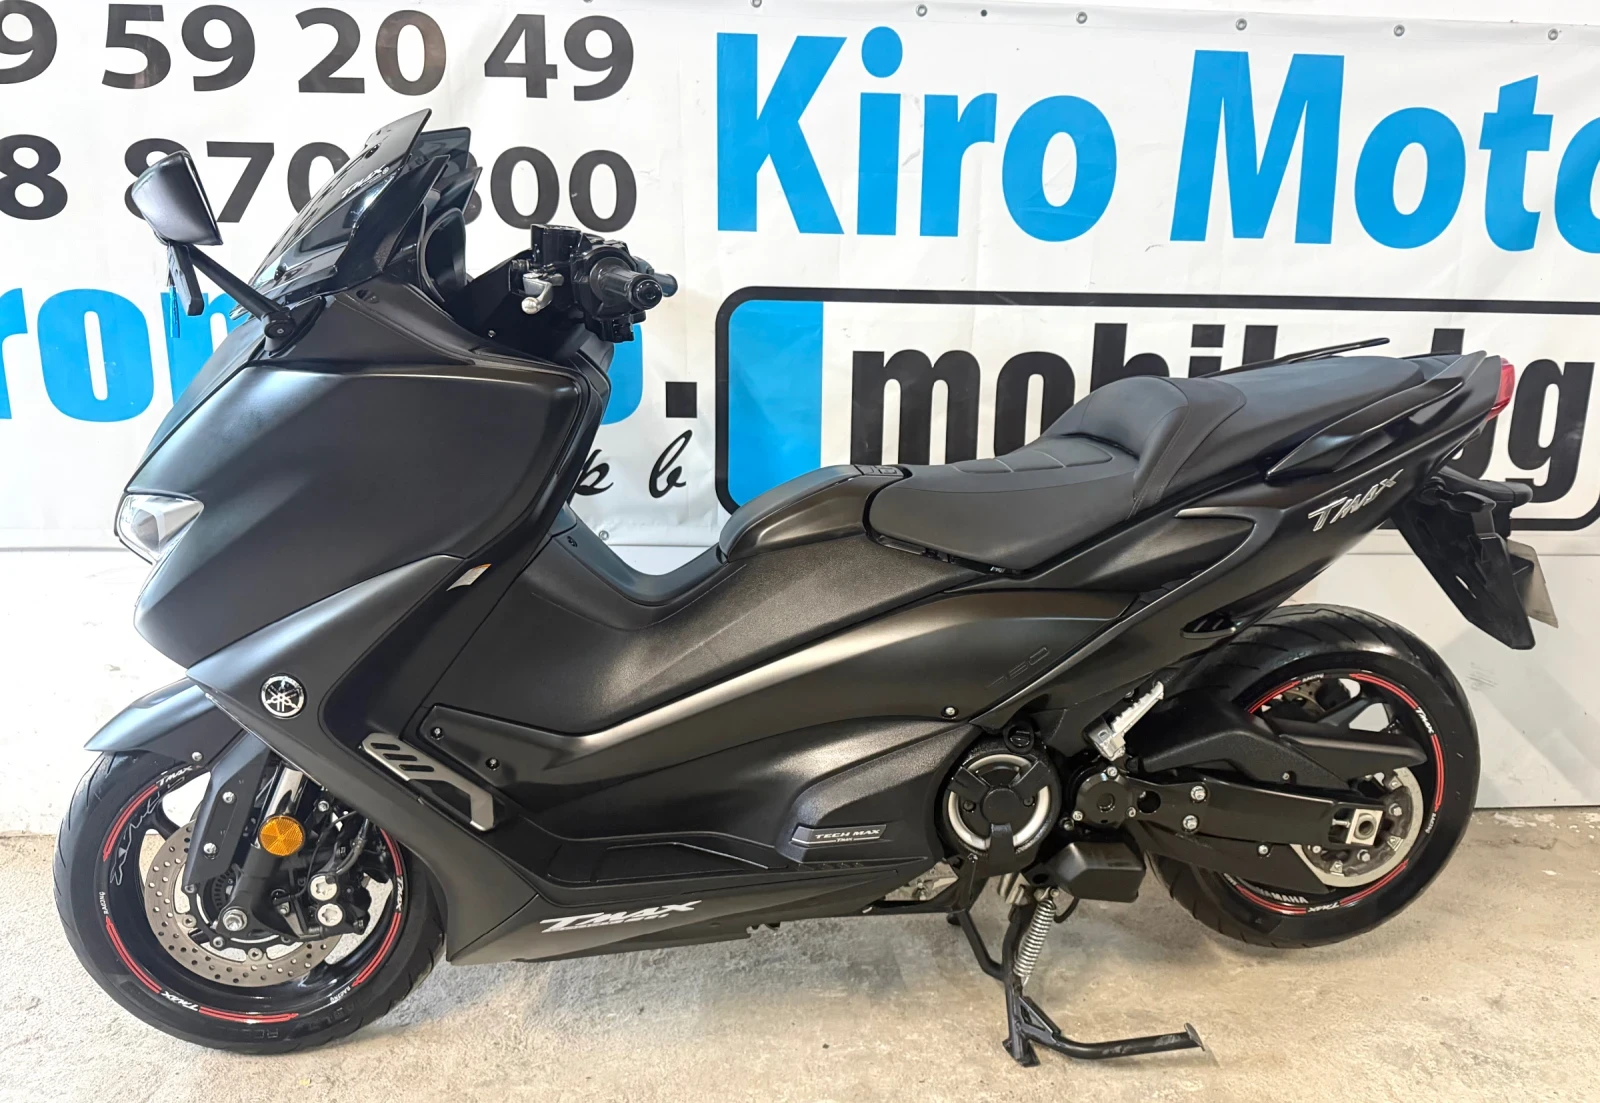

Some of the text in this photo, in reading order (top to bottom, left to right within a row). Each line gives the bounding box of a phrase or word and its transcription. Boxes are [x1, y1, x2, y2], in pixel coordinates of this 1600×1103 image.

[102, 4, 255, 91] 59
[296, 8, 446, 95] 20
[485, 14, 634, 100] 49
[0, 134, 68, 220] 8
[717, 26, 1117, 243] Kiro
[815, 831, 851, 839] TECH
